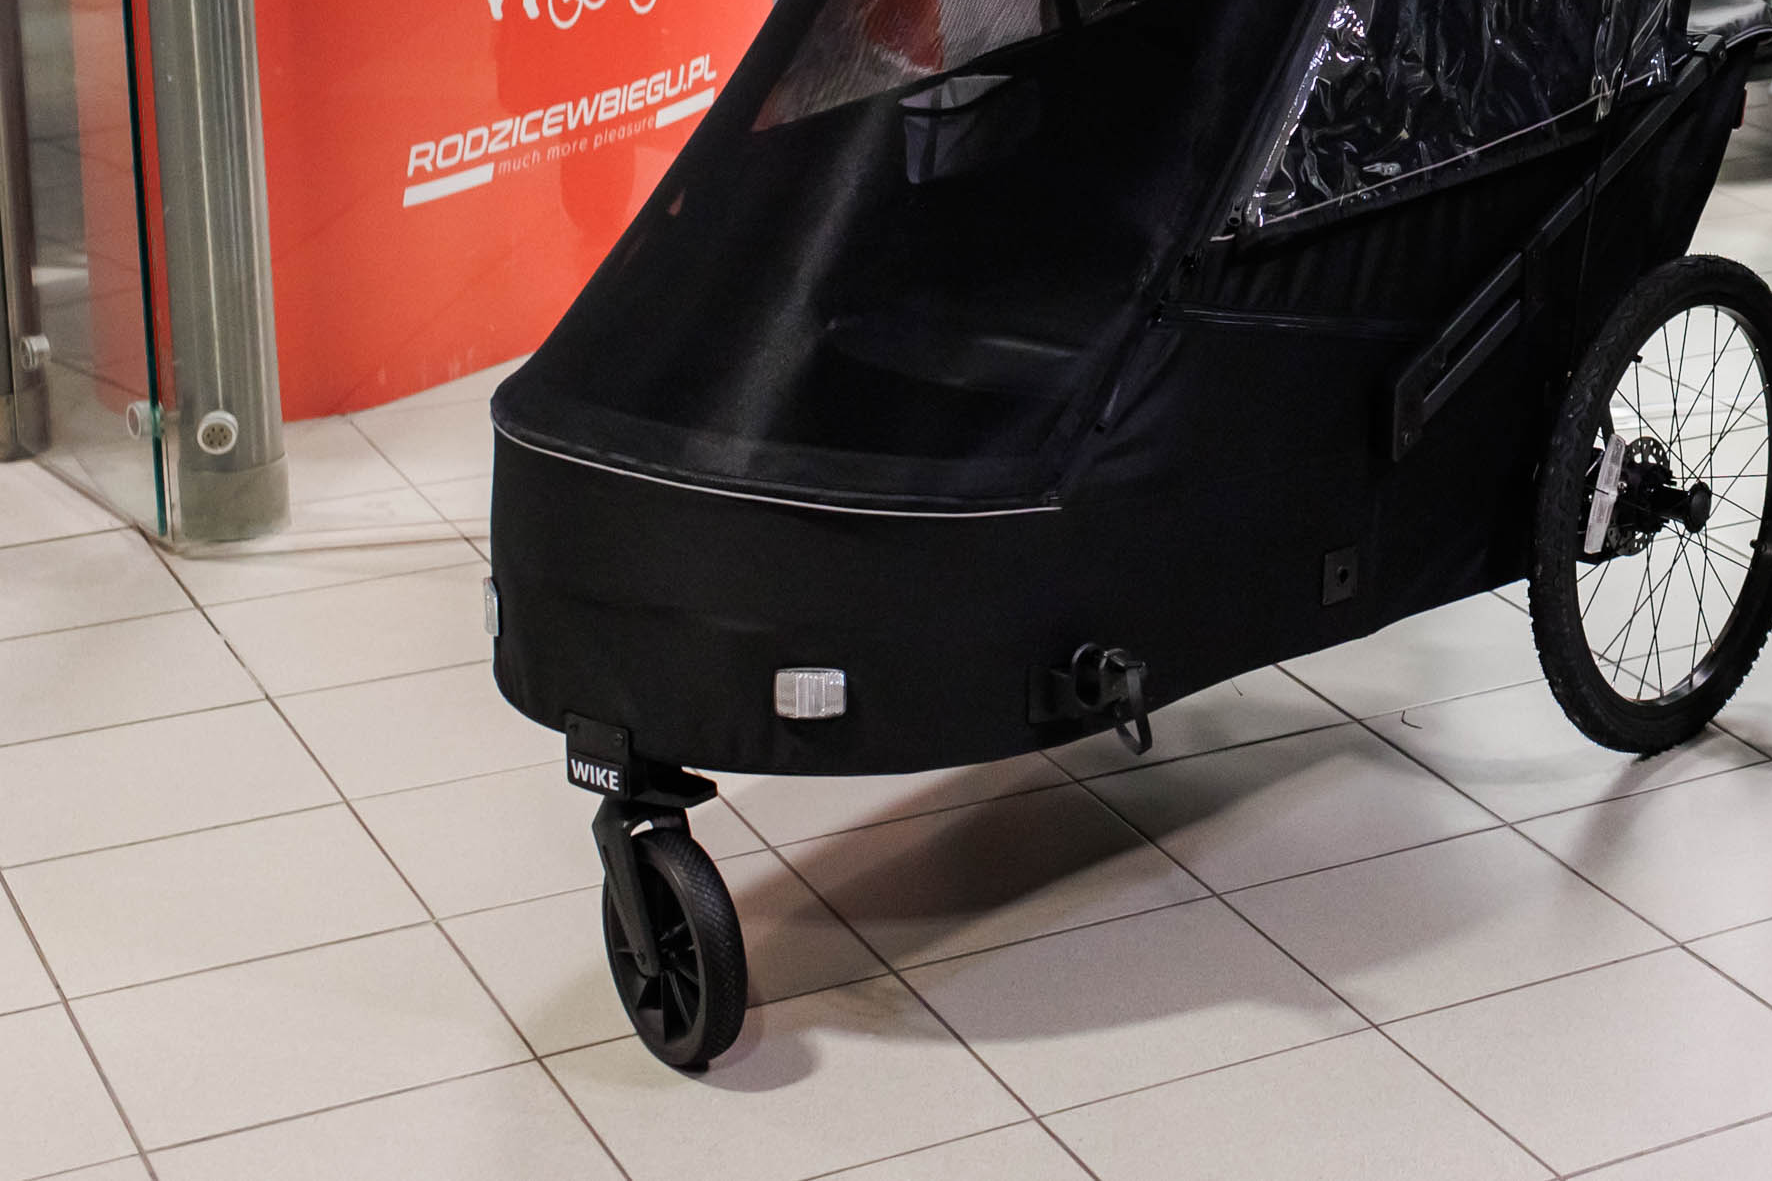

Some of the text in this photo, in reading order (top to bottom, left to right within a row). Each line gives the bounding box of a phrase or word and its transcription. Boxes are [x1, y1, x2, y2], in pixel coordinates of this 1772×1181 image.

[407, 53, 717, 178] RODZICEWBIEGU.PL
[498, 115, 656, 175] much more pleasure
[570, 758, 620, 792] WIKE
